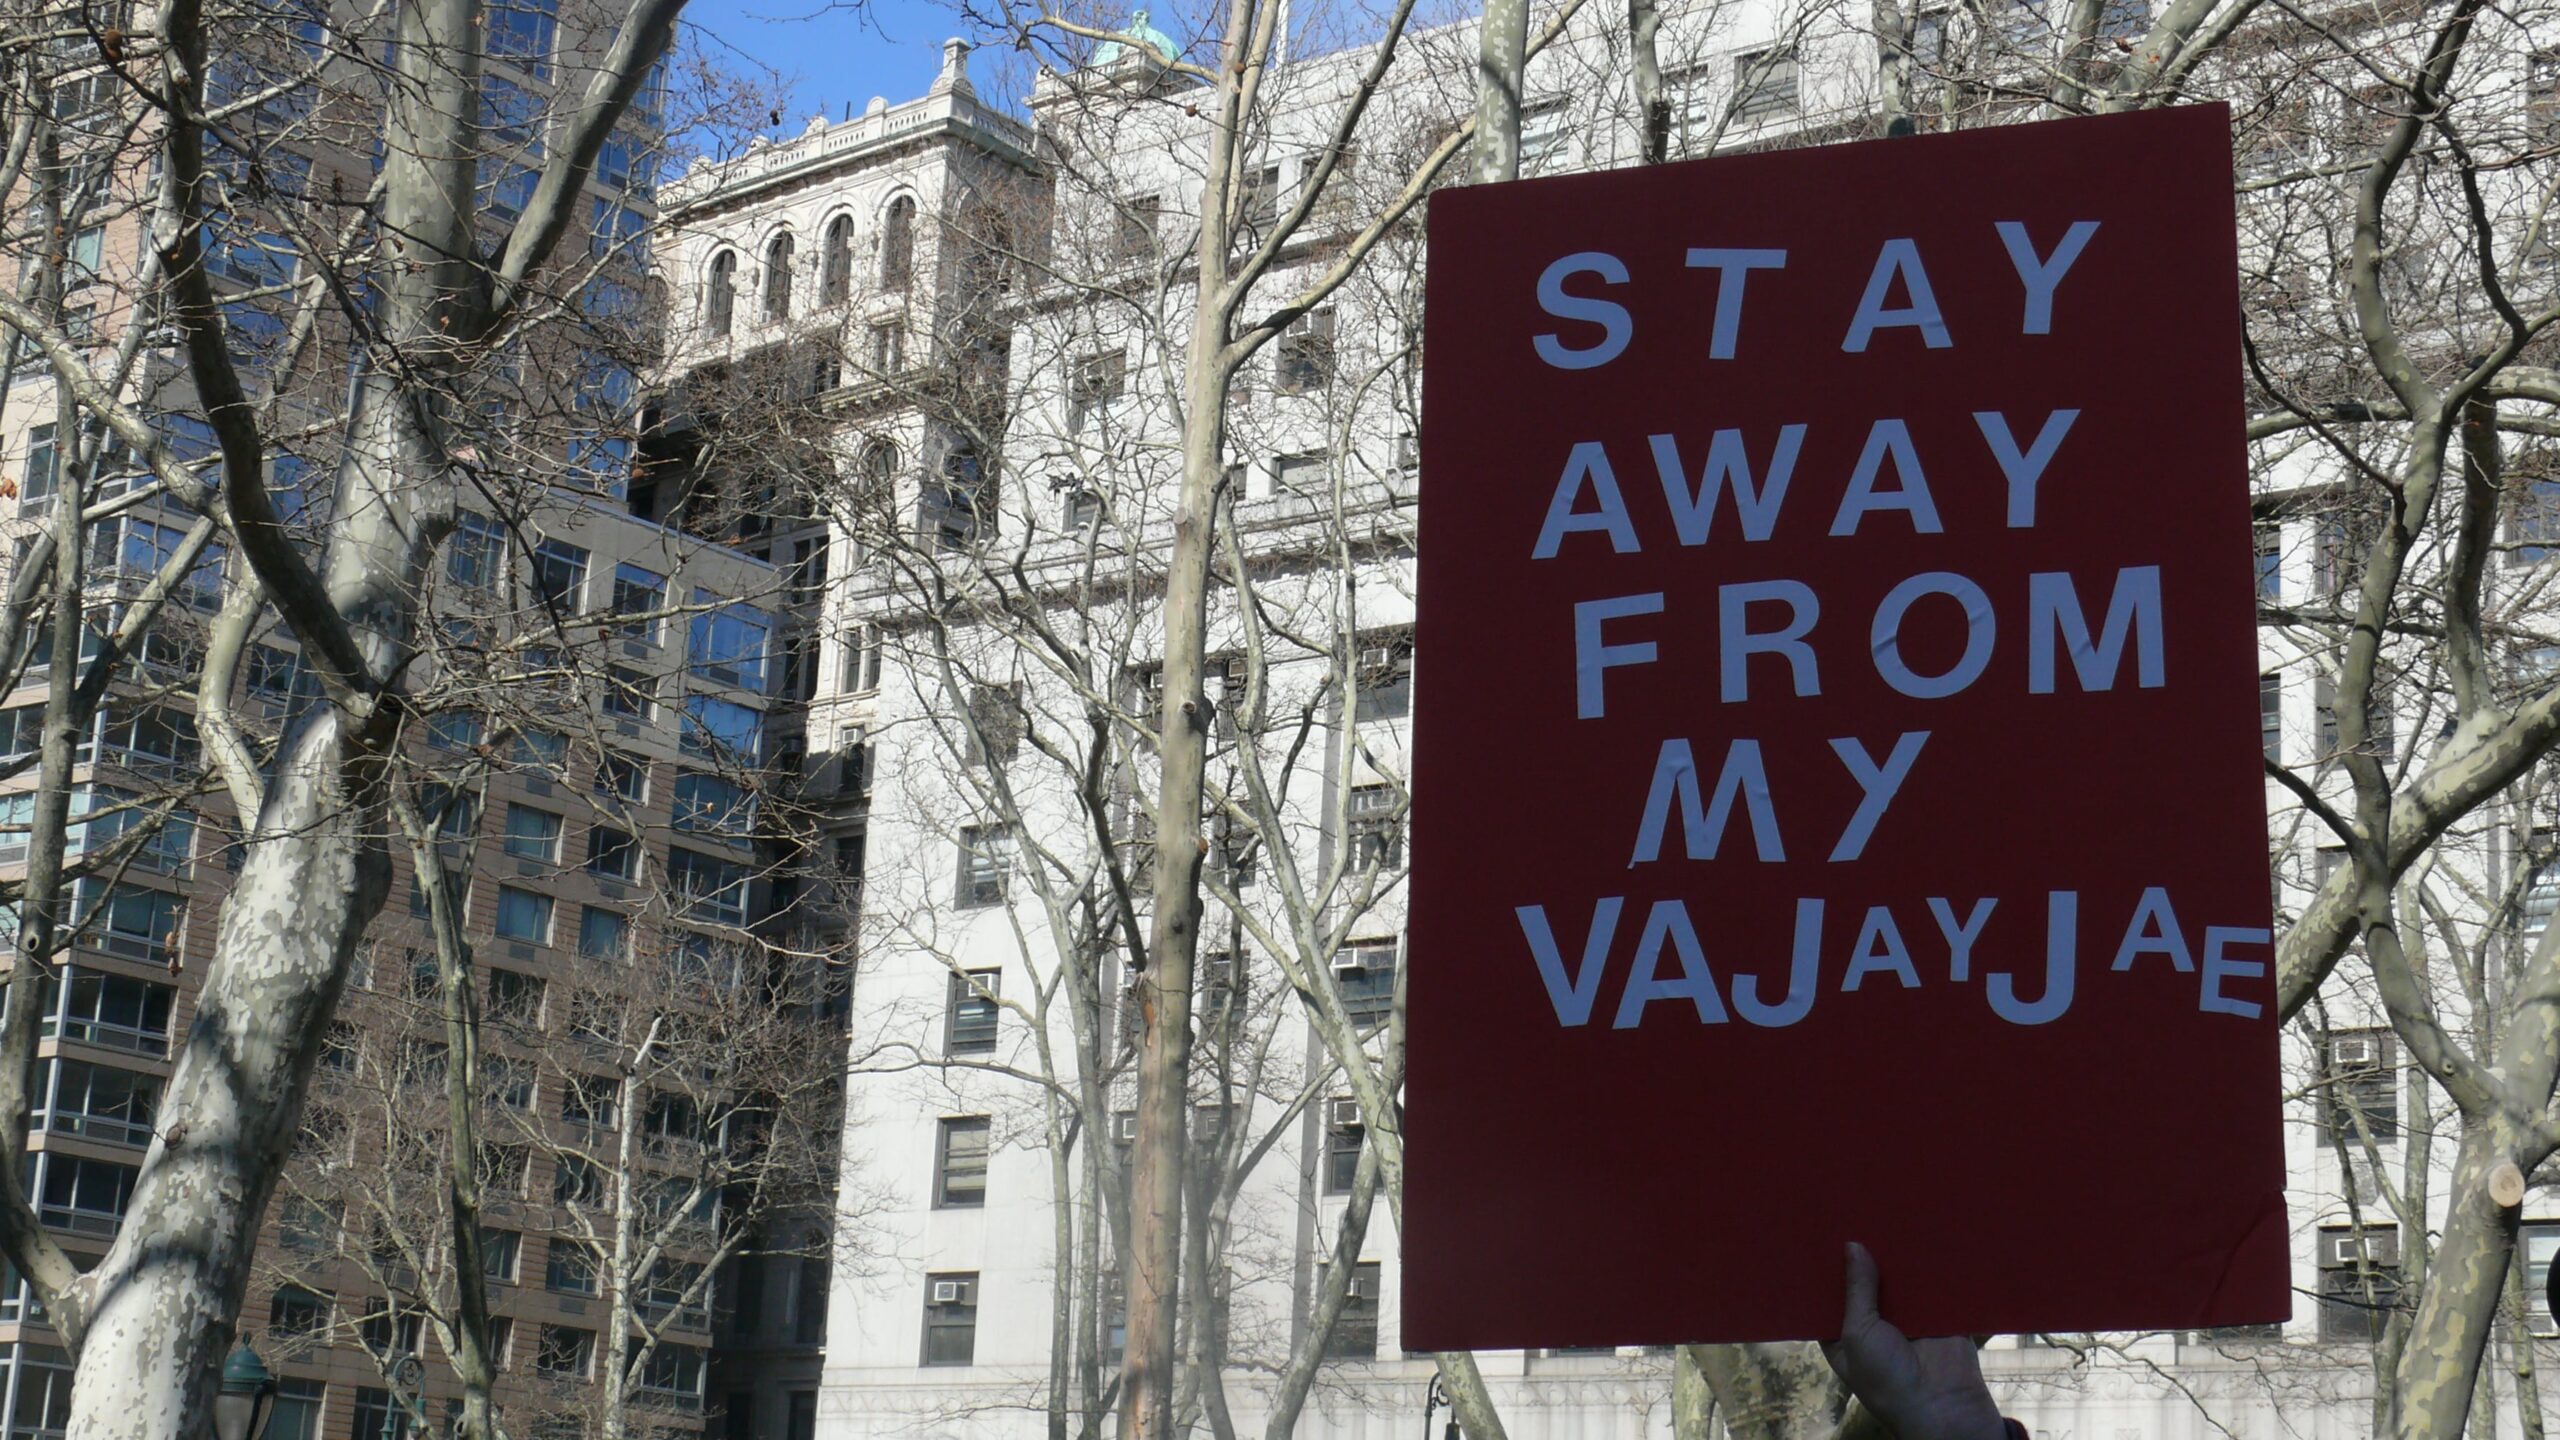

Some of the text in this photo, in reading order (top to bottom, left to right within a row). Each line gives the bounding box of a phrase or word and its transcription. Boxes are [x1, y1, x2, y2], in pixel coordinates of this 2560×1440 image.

[1533, 221, 2101, 369] STAY
[1531, 409, 2081, 559] AWAY
[1574, 565, 2165, 720] FROM
[1628, 731, 1931, 869] MY
[1515, 887, 2271, 1029] VAJAYJAE
